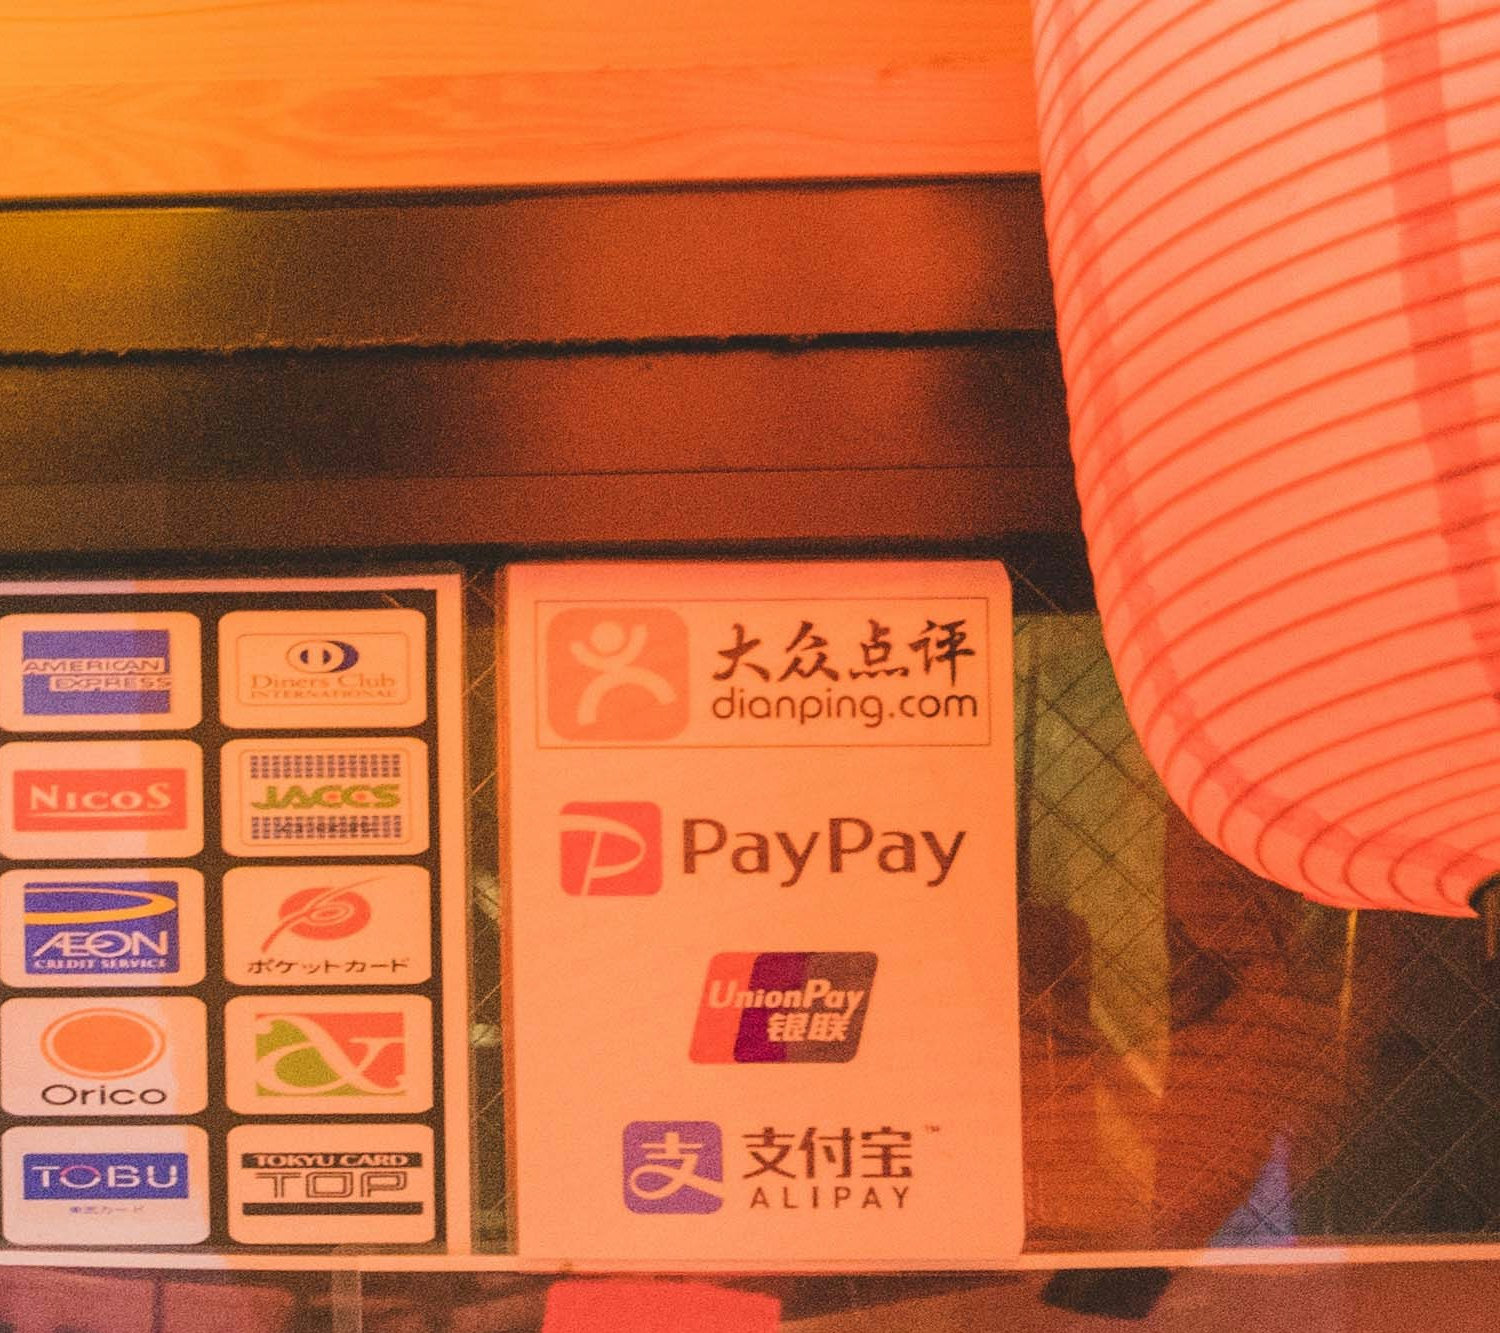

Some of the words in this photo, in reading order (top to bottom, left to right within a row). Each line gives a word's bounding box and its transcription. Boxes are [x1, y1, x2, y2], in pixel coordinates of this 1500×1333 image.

[712, 617, 978, 686] 大众点评
[23, 656, 168, 675] AMERICAN
[53, 675, 173, 693] EXPRESS
[336, 670, 397, 690] Club
[711, 686, 979, 729] dianping.com
[251, 784, 401, 810] JACCS
[681, 816, 968, 889] PayPay
[247, 958, 409, 979] ポケットカード
[708, 978, 866, 1016] UnionPay
[40, 1083, 168, 1106] Orico
[255, 1153, 337, 1168] TOKYU
[341, 1153, 409, 1167] CARD
[742, 1125, 913, 1181] 支付宝
[31, 1165, 179, 1189] TOBU
[254, 1170, 408, 1199] TOP
[750, 1187, 912, 1210] ALIPAY
